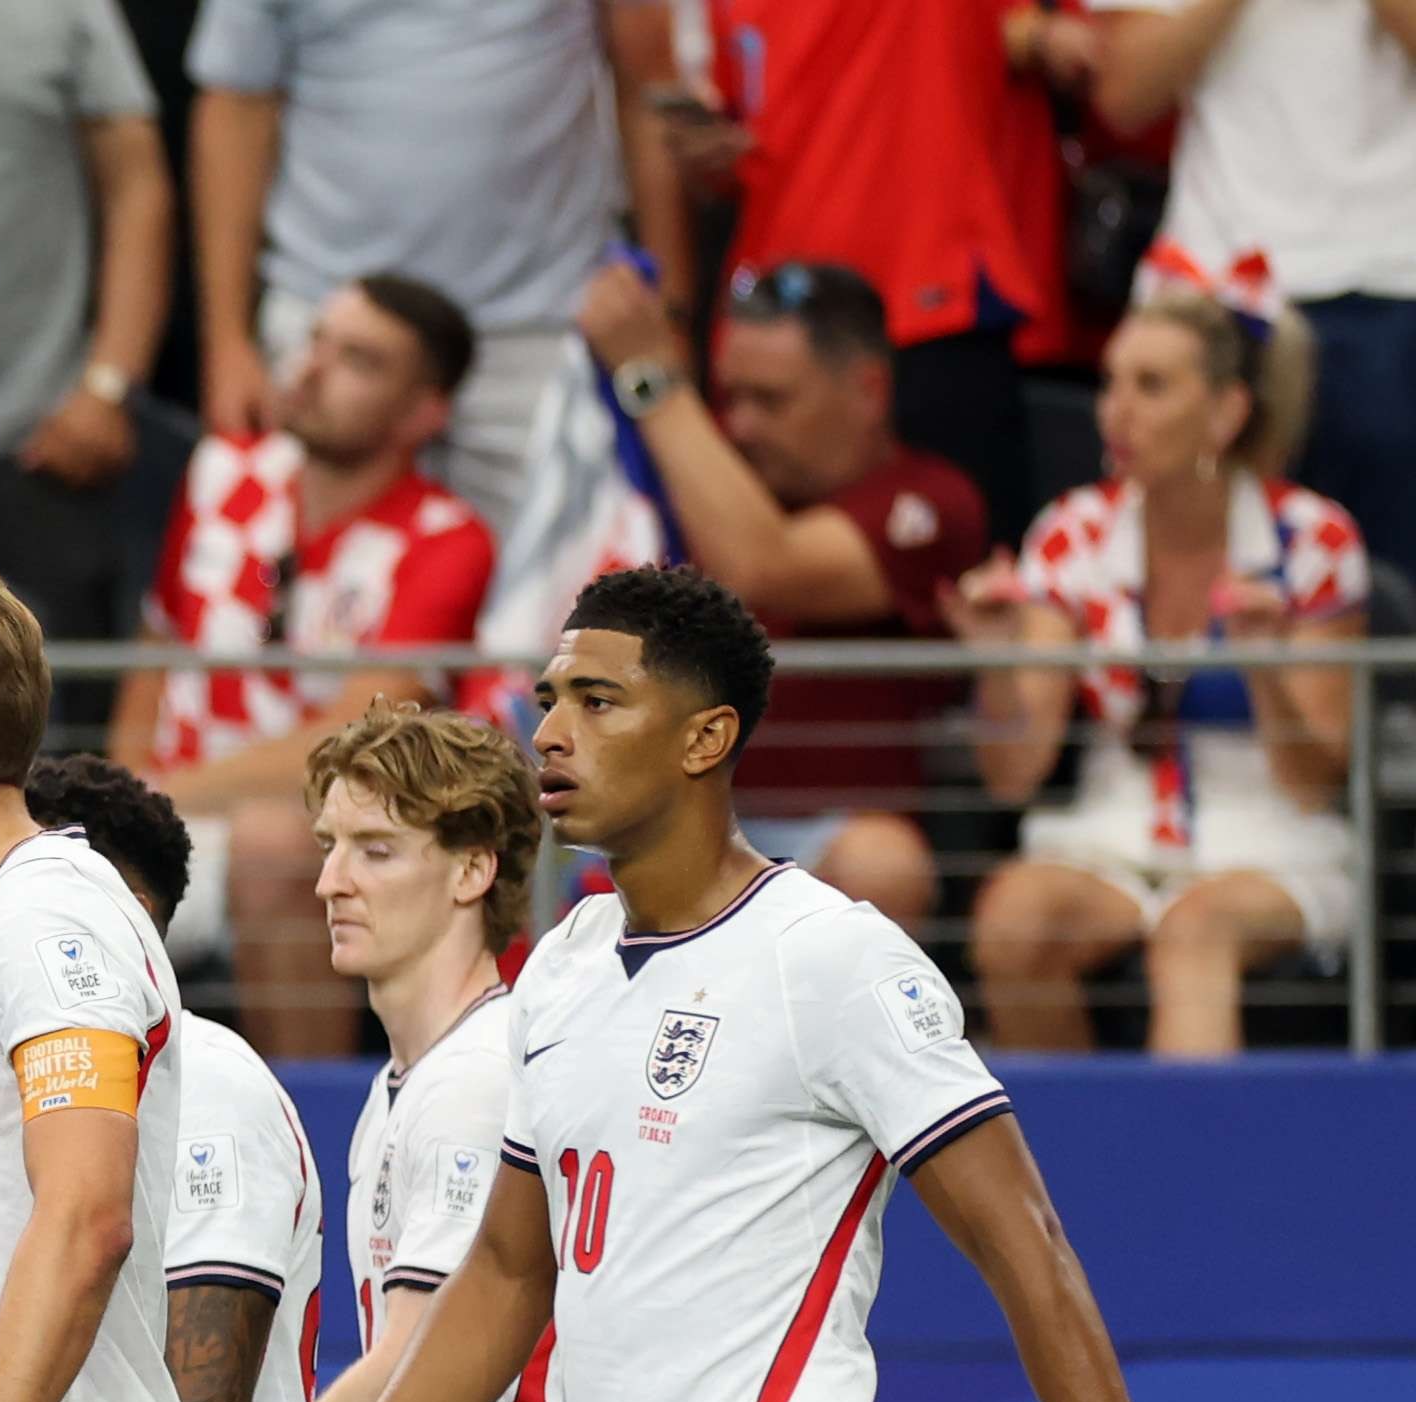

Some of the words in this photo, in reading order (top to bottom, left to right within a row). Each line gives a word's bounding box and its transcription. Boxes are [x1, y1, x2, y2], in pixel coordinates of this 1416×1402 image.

[68, 973, 101, 990] PEACE
[913, 1011, 944, 1033] PEACE
[23, 1037, 92, 1062] FOOTBALL
[24, 1051, 93, 1083] UNITES
[45, 1071, 99, 1094] World
[41, 1096, 68, 1108] FIFA
[639, 1105, 679, 1124] CROATIA
[190, 1181, 222, 1197] PEACE
[558, 1147, 615, 1275] 10
[359, 1277, 374, 1354] 1
